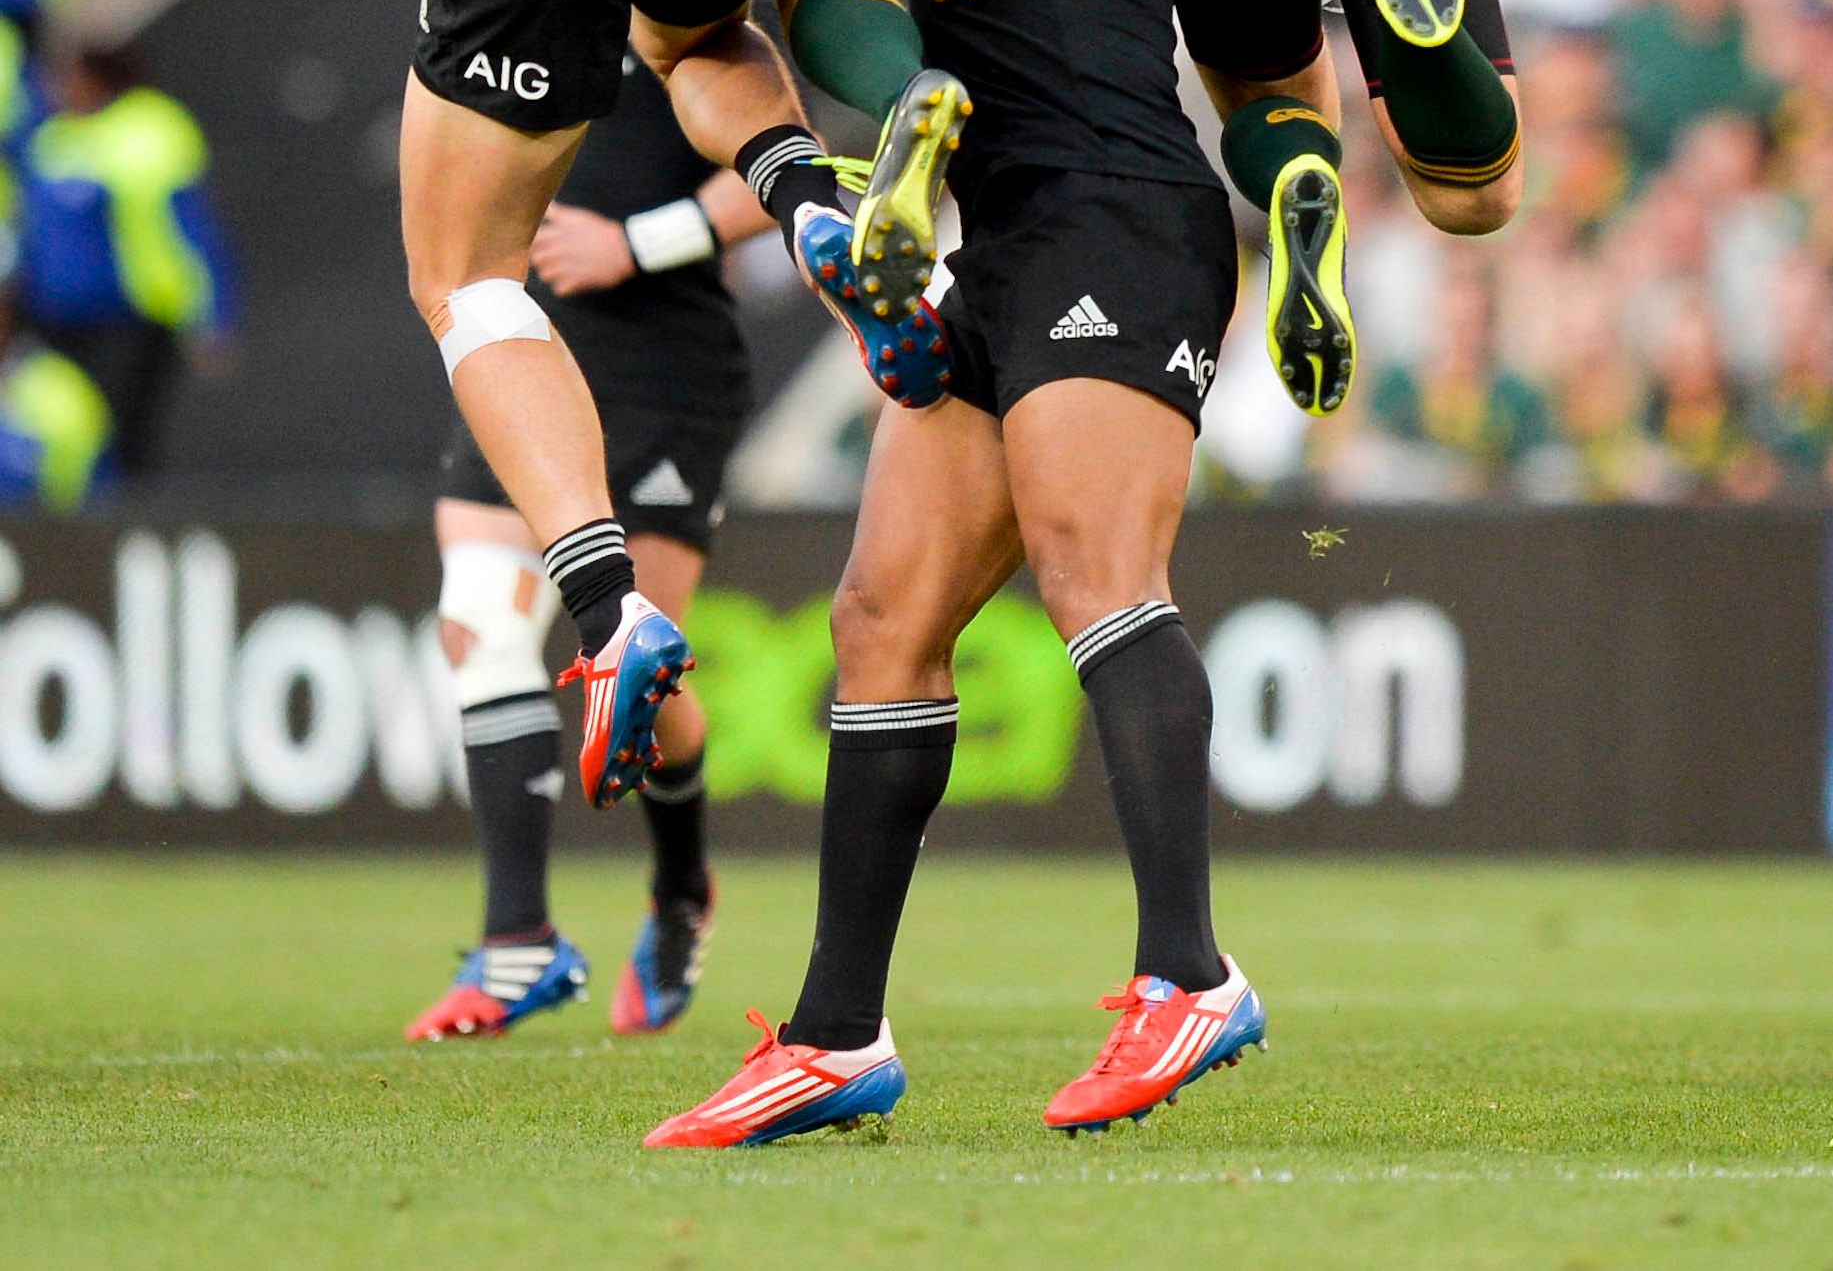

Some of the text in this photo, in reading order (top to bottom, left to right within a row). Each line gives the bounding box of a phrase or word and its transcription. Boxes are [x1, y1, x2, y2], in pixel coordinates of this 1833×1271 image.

[463, 51, 550, 100] AIG
[1049, 321, 1120, 340] adidas
[0, 528, 475, 814] ollow
[1203, 597, 1466, 812] on
